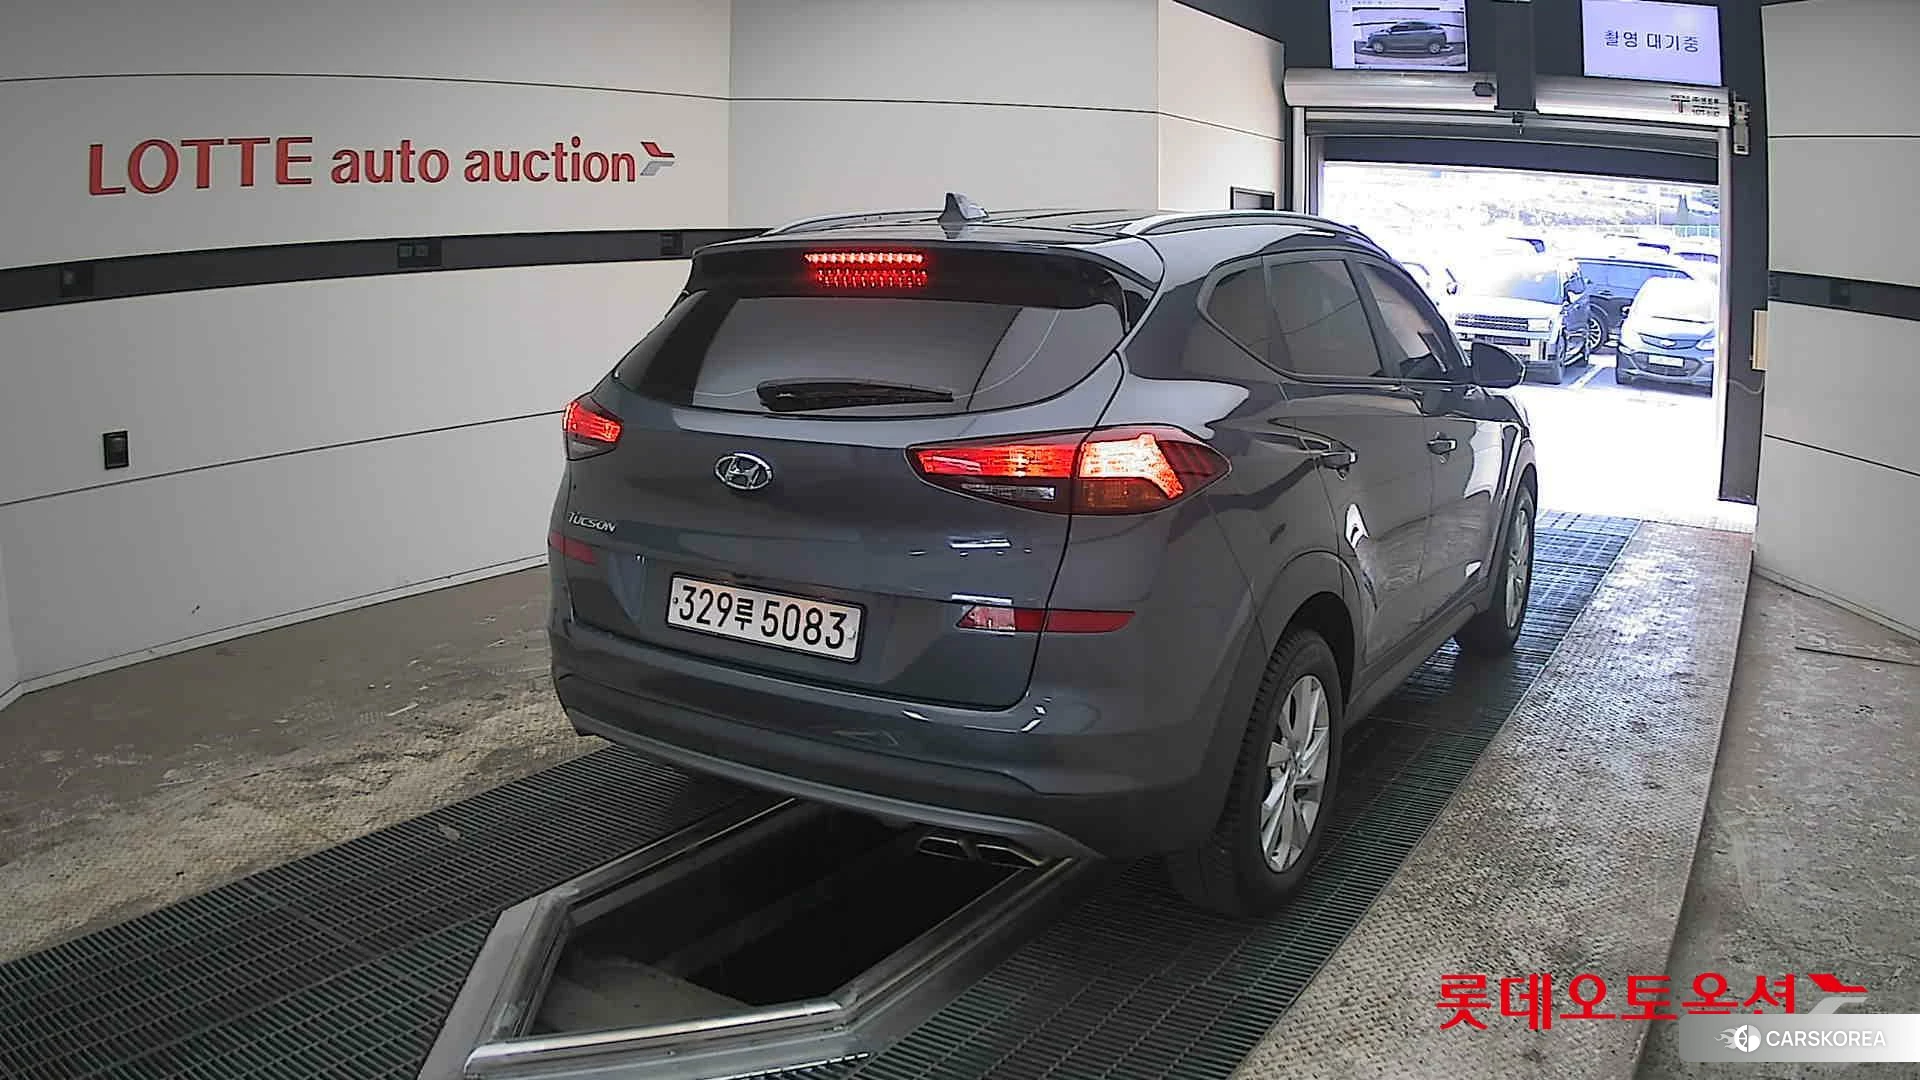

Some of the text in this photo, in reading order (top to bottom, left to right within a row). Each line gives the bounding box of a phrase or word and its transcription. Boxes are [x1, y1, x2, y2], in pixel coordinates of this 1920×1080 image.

[1604, 30, 1698, 53] 촬영 대기중
[88, 135, 636, 196] LOTTE auto auction
[568, 511, 617, 533] TUCSON
[760, 601, 848, 650] 5083
